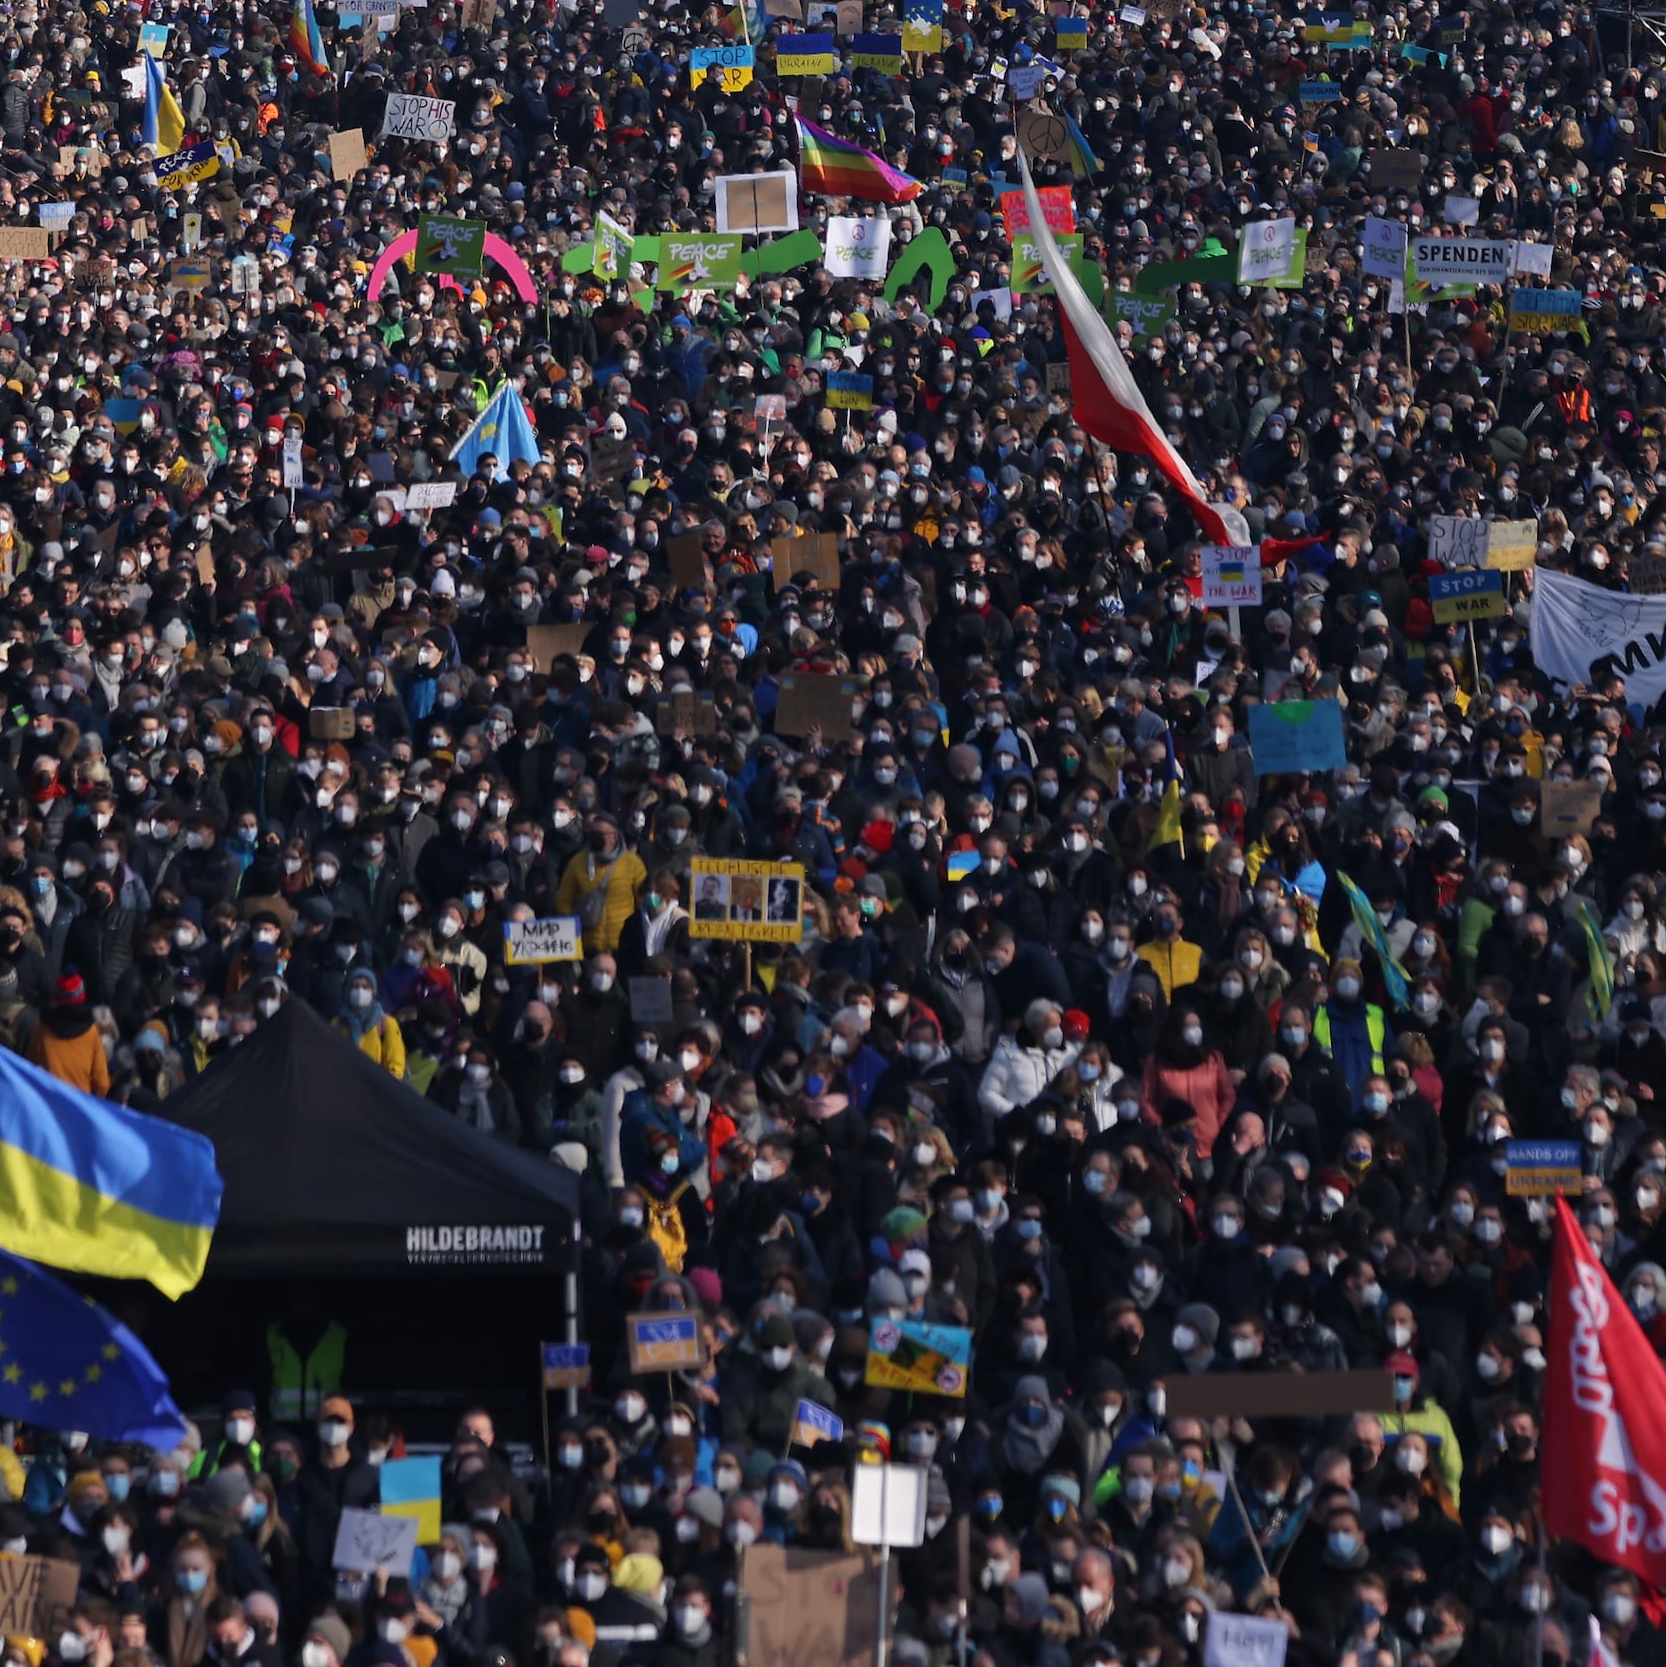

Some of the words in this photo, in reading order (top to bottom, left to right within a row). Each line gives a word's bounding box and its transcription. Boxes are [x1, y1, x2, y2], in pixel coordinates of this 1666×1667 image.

[700, 49, 746, 66] STOP
[390, 95, 428, 120] STOP
[429, 103, 453, 120] HIS
[389, 115, 424, 137] WAR
[158, 149, 196, 172] PEACE
[425, 222, 479, 241] PEACE
[669, 241, 735, 261] PEACE
[835, 245, 880, 261] PEACE
[1419, 244, 1503, 262] SPENDEN
[1115, 296, 1166, 318] PEACE
[1433, 519, 1487, 540] STOP
[1214, 546, 1252, 562] STOP
[1434, 540, 1481, 569] WAR
[1207, 584, 1227, 597] THE
[1231, 585, 1257, 598] WAR
[1440, 575, 1485, 593] STOP
[1455, 596, 1490, 612] WAR
[406, 1225, 544, 1252] HILDEBRANDT
